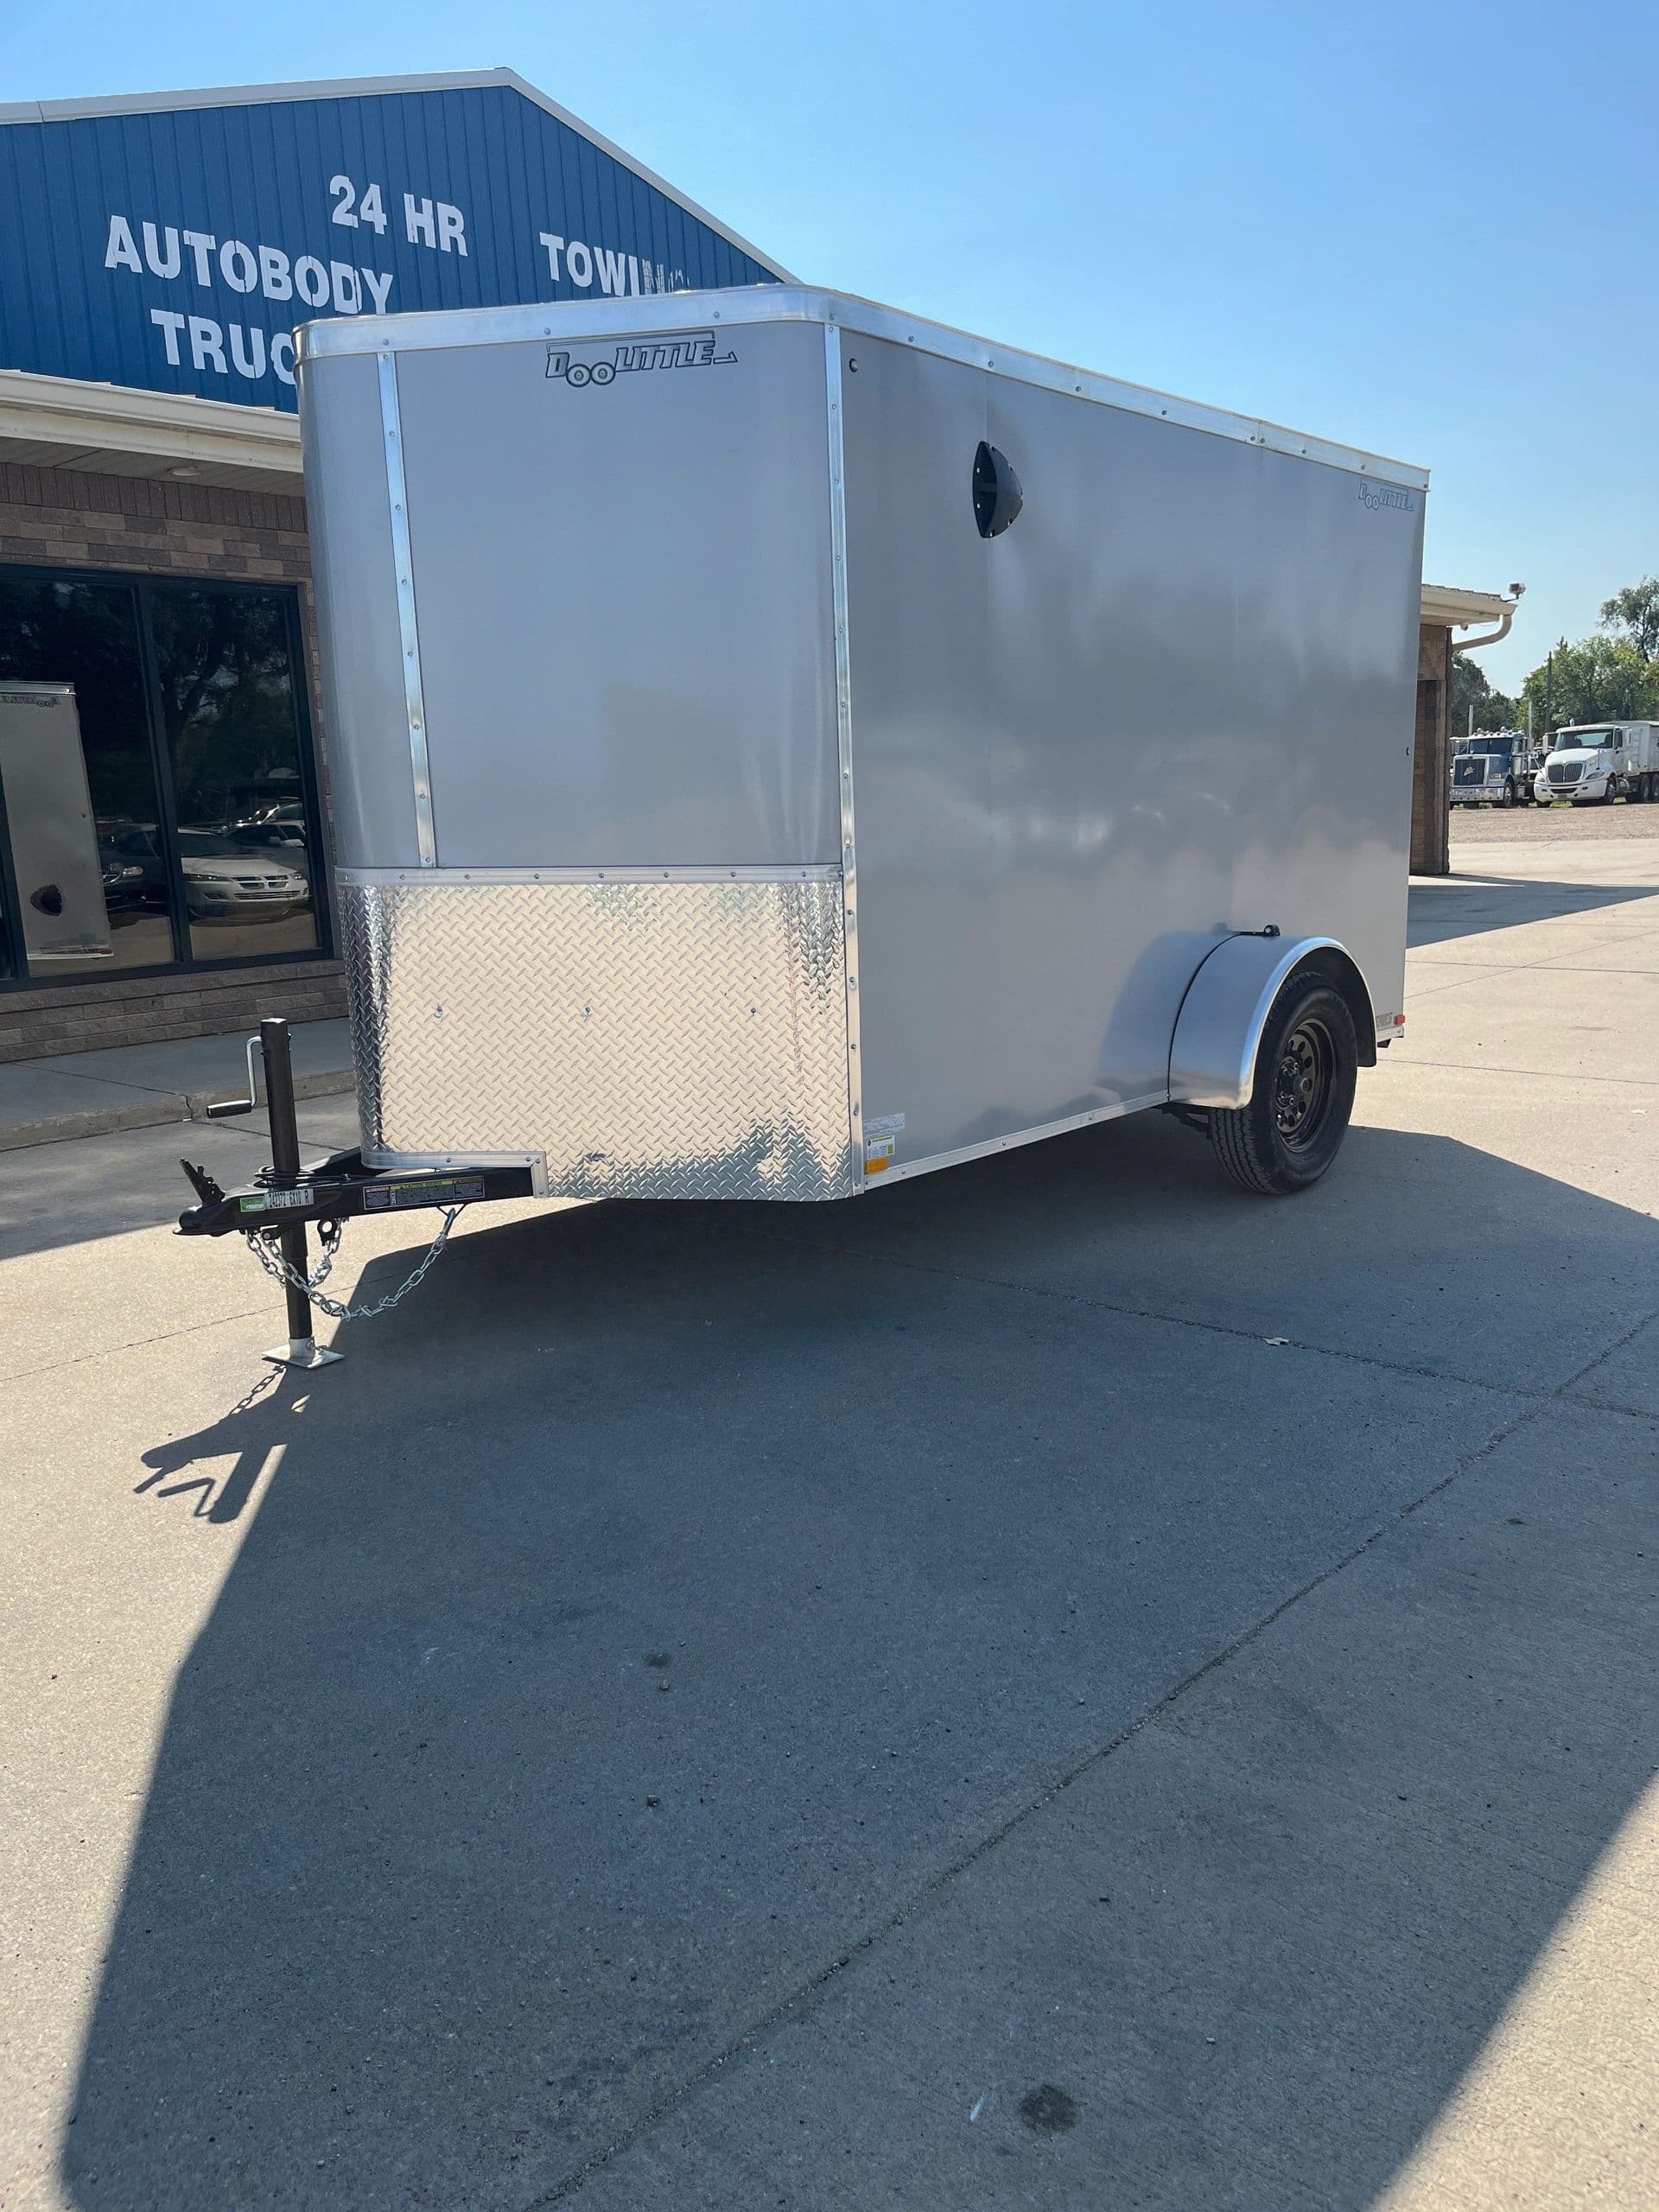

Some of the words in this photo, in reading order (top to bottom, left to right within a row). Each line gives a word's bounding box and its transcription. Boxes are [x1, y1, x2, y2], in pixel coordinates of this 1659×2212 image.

[329, 175, 388, 235] 24
[404, 193, 468, 257] HR
[105, 214, 393, 315] AUTOBODY
[545, 340, 716, 387] DOOLITTLE
[304, 1190, 309, 1205] R
